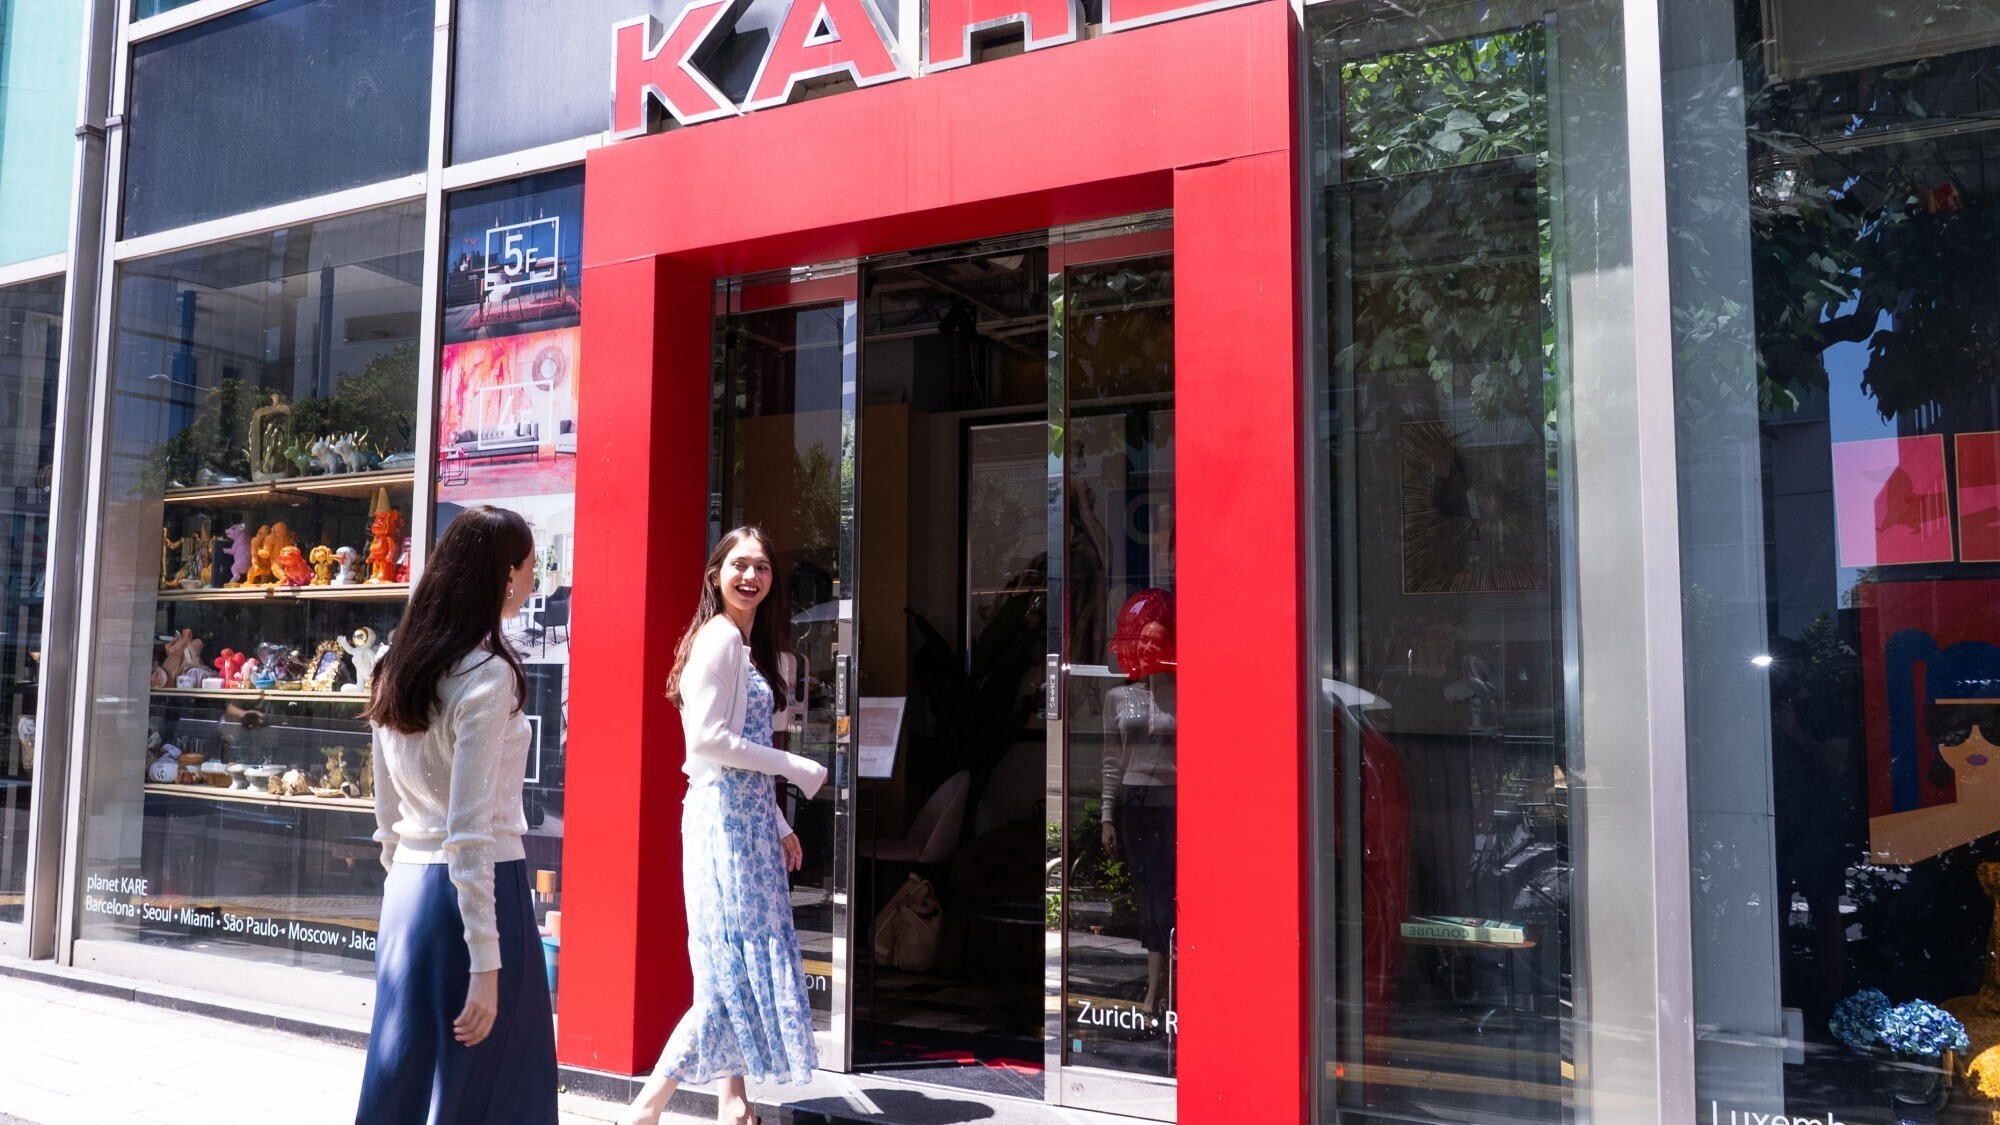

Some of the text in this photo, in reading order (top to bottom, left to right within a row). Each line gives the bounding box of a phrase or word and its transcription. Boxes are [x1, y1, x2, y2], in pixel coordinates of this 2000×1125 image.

[608, 0, 1262, 141] KA
[504, 234, 539, 277] 5F
[86, 874, 148, 896] planet KARE
[85, 895, 134, 918] Barcelona
[143, 905, 172, 922] Seoul
[180, 908, 214, 928] Miami
[223, 913, 244, 931] São
[246, 918, 278, 938] Paulo
[288, 922, 339, 946] Moscow
[1078, 1000, 1145, 1030] Zurich
